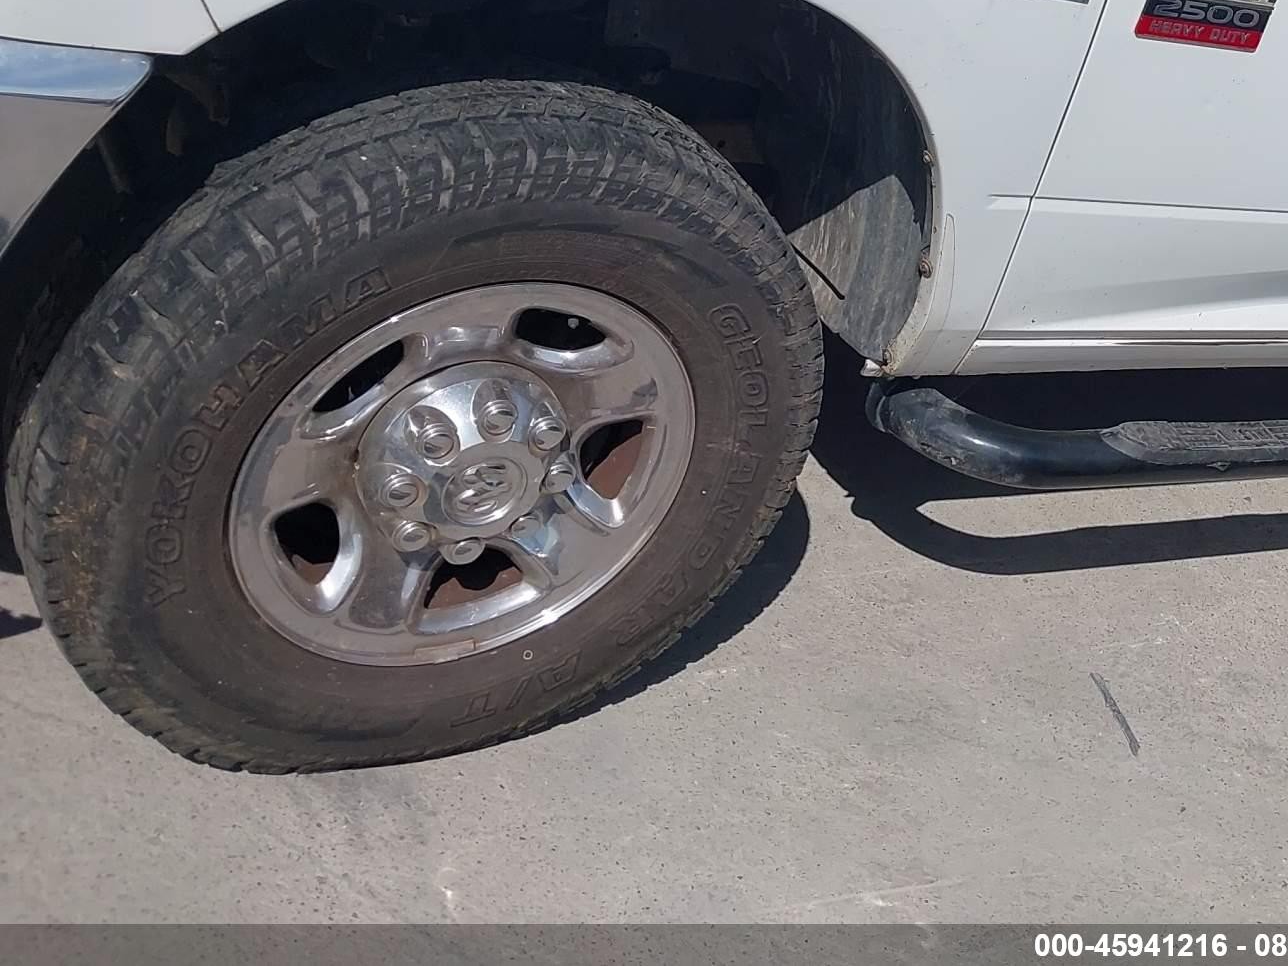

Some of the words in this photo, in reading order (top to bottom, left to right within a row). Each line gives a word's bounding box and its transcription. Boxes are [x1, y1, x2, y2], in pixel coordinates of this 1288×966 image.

[1149, 19, 1203, 39] HEAVY
[1208, 28, 1253, 45] DUTY
[143, 266, 392, 607] YOKOHAMA
[608, 303, 769, 647] GEOLANDAR
[451, 651, 581, 729] A/T
